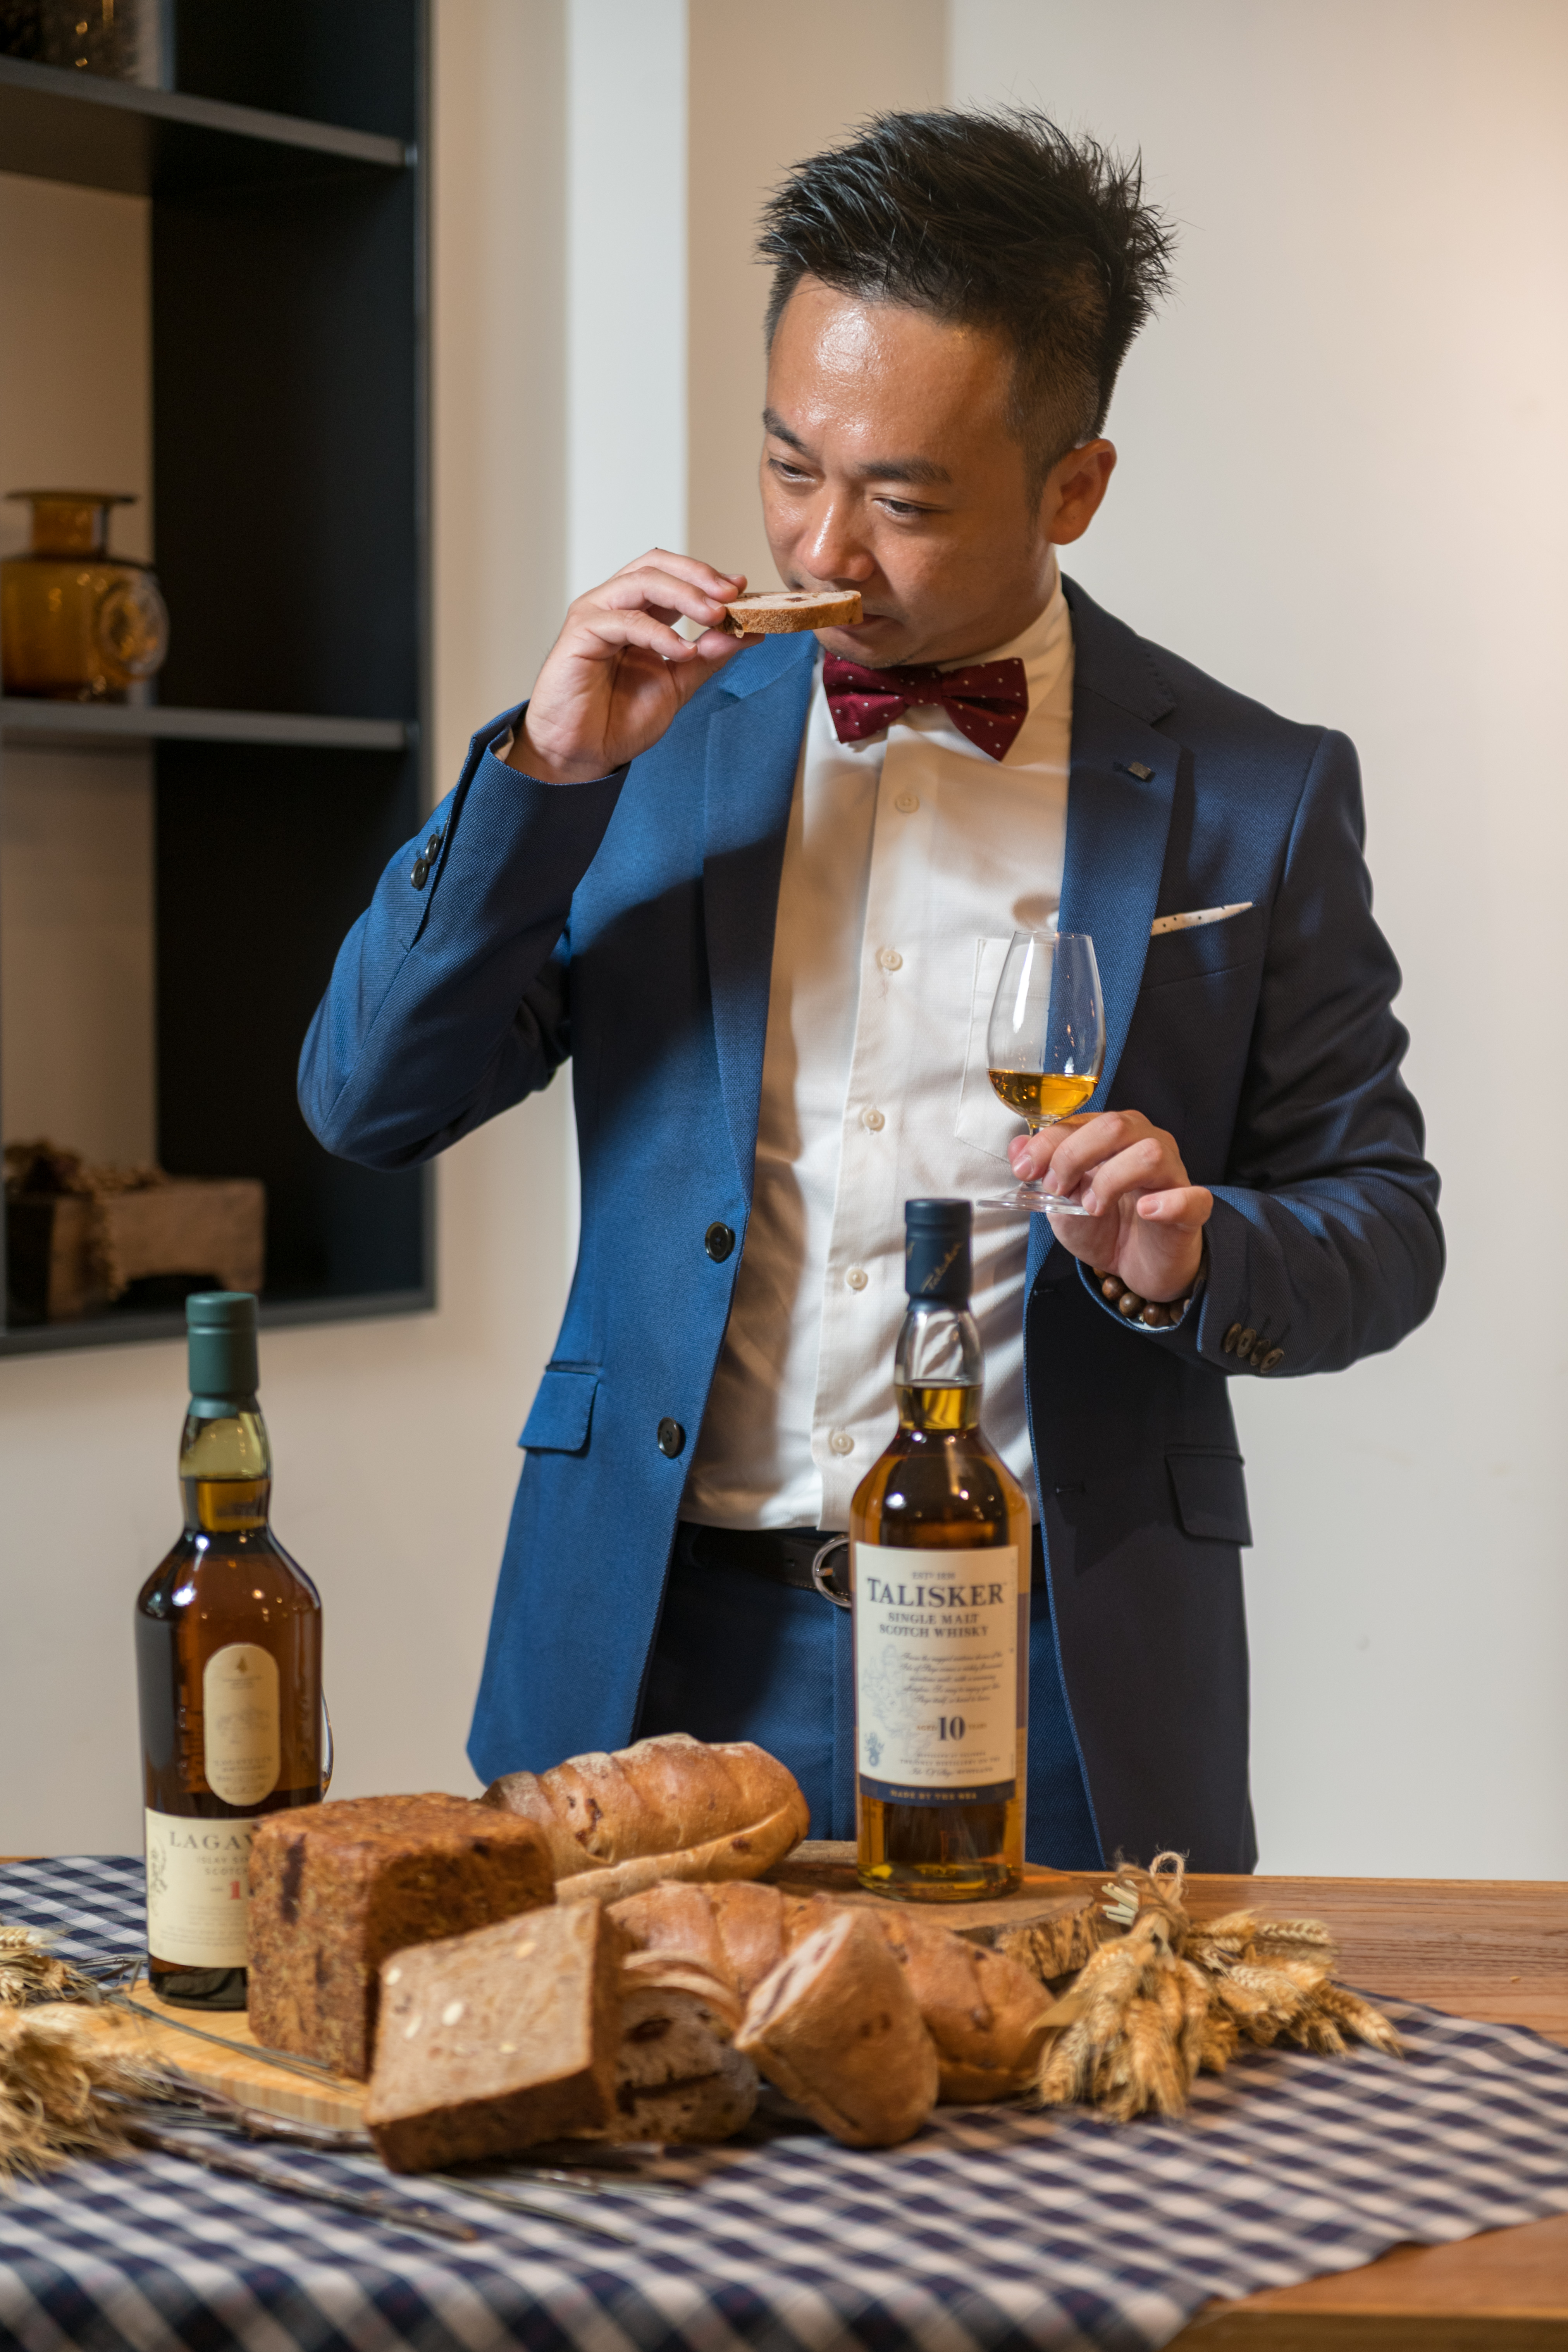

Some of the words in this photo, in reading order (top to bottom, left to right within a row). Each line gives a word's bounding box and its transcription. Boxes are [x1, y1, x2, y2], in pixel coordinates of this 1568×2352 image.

[867, 1577, 1004, 1608] TALISKER
[888, 1612, 937, 1624] SINGLE
[941, 1613, 979, 1624] MALT
[880, 1624, 929, 1638] SCOTCH
[934, 1626, 989, 1638] WHISKY
[937, 1716, 966, 1741] 10
[890, 1790, 915, 1799] MADE
[958, 1792, 977, 1800] SEA
